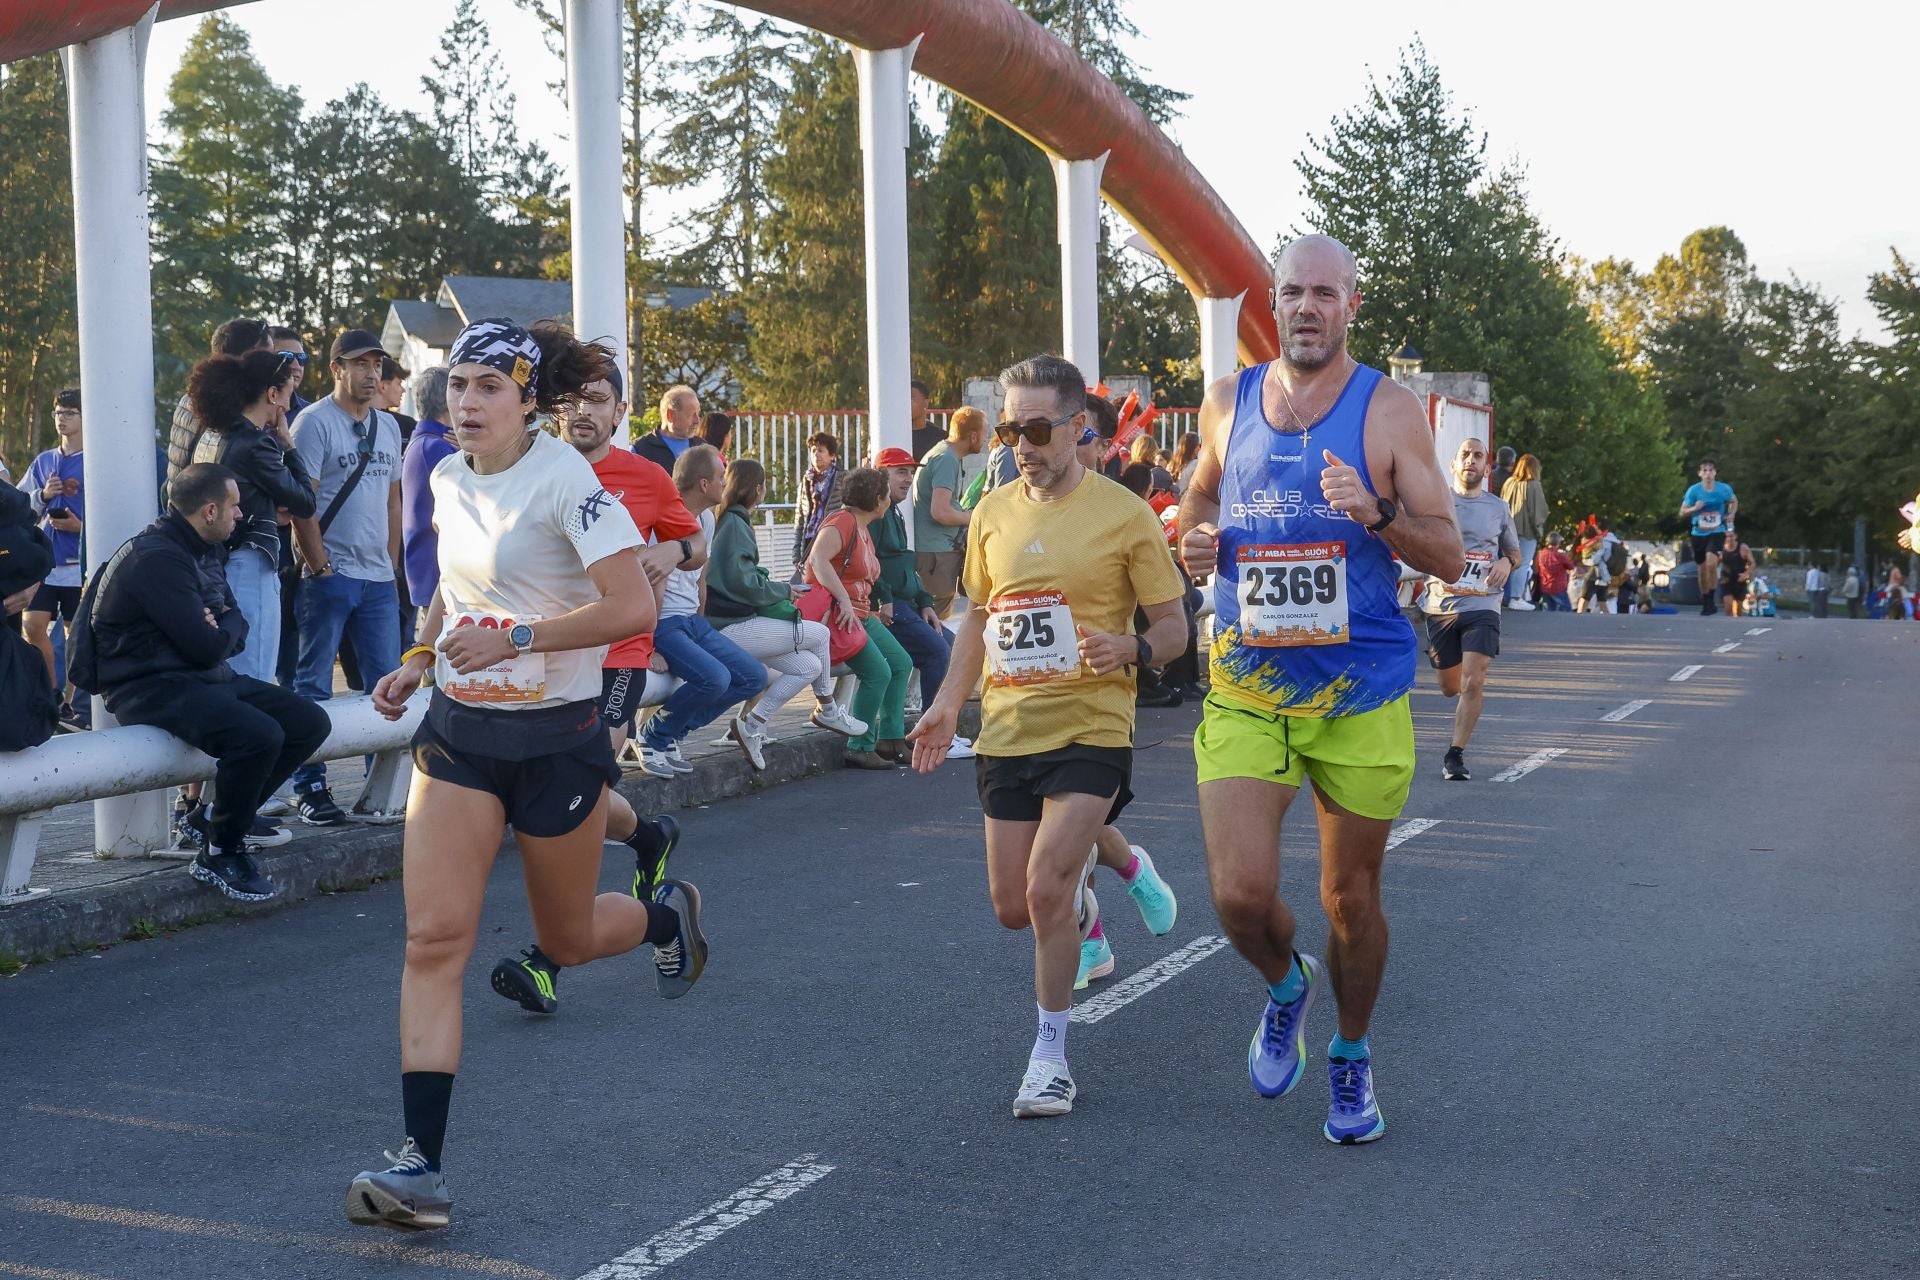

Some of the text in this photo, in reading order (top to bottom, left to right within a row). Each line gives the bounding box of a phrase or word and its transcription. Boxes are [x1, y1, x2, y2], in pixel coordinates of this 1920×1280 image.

[1252, 490, 1302, 503] CLUB
[1265, 550, 1287, 558] MBA
[1246, 564, 1337, 607] 2369
[997, 610, 1055, 651] 525
